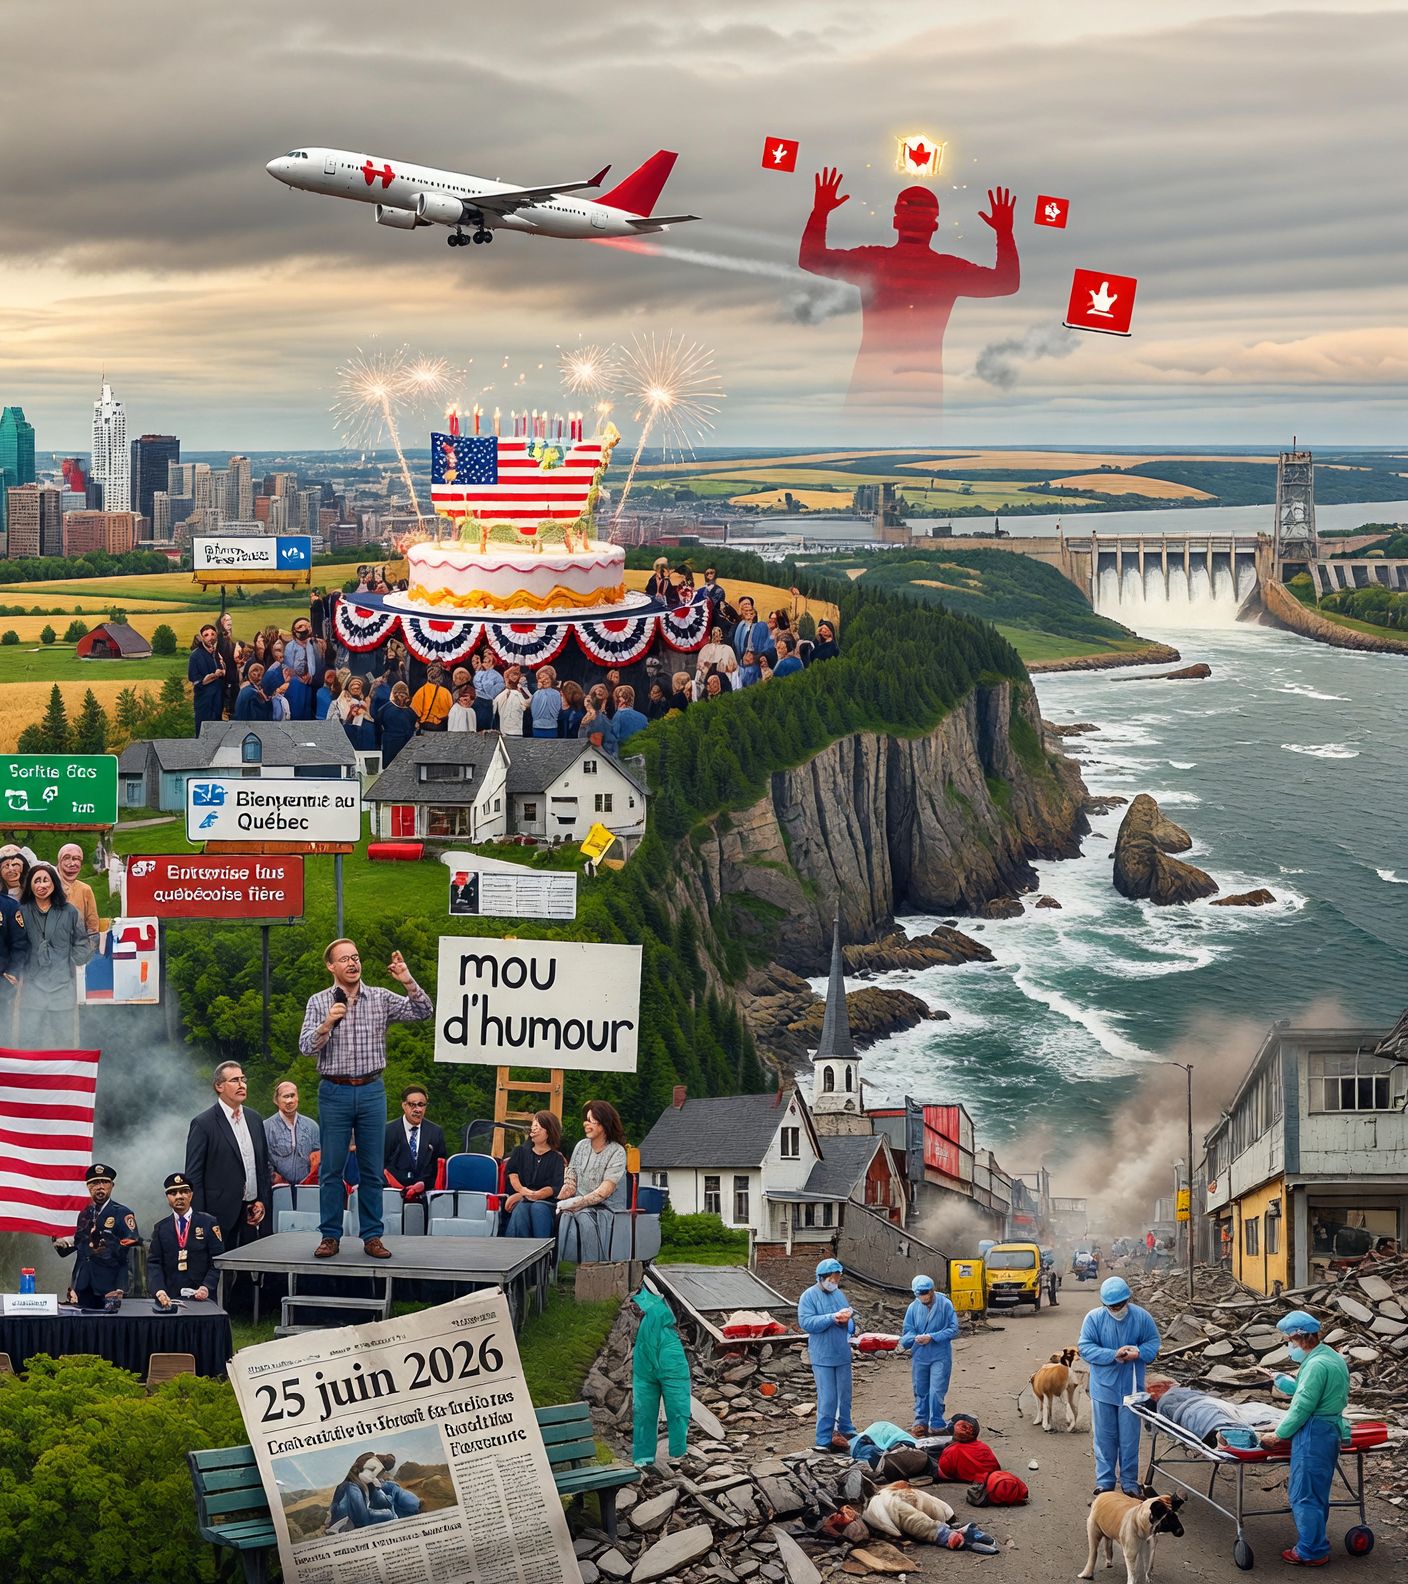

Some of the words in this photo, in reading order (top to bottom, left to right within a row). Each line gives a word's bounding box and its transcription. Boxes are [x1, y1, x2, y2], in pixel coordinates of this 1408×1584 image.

[335, 795, 355, 808] au
[237, 811, 309, 831] Québec
[459, 953, 557, 991] mou
[443, 993, 634, 1053] d'humour
[255, 1377, 306, 1422] 25
[314, 1362, 400, 1422] juin
[403, 1333, 504, 1391] 2026
